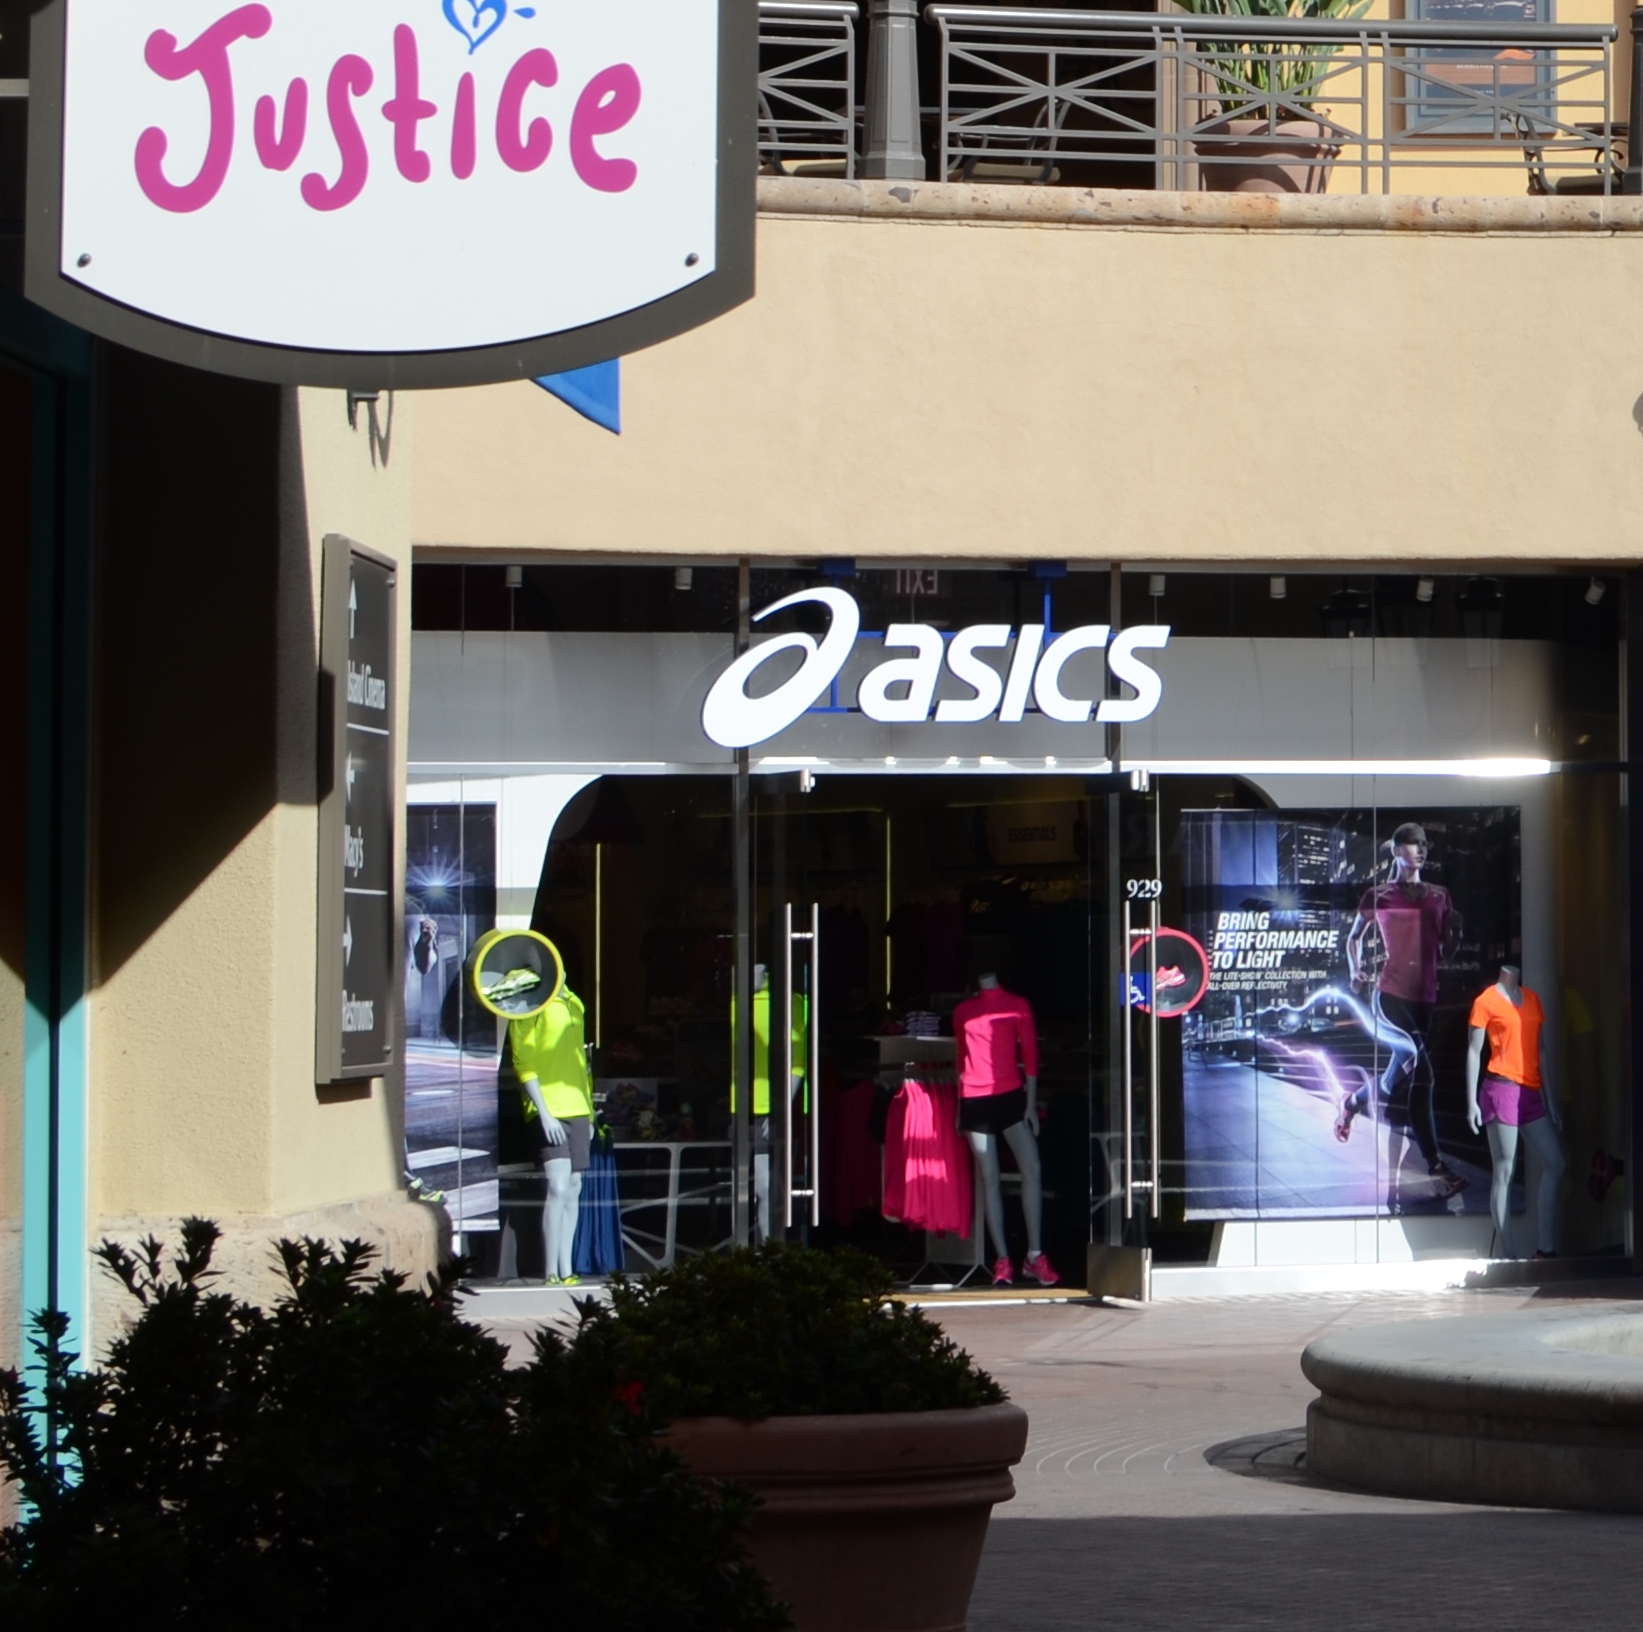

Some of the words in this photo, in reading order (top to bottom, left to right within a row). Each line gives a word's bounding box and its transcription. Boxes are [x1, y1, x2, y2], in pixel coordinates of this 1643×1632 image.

[133, 2, 643, 213] Justice
[347, 659, 364, 705] Island
[365, 664, 386, 710] Cinema
[857, 623, 1171, 723] asics
[344, 824, 364, 877] Macy's
[1126, 879, 1163, 898] 929
[1217, 911, 1270, 930] BRING
[1213, 930, 1339, 949] PERFORMANCE
[1212, 950, 1234, 969] TO
[1235, 950, 1286, 969] LIGHT
[1264, 970, 1307, 980] COLLECTION
[342, 989, 374, 1032] Restrooms
